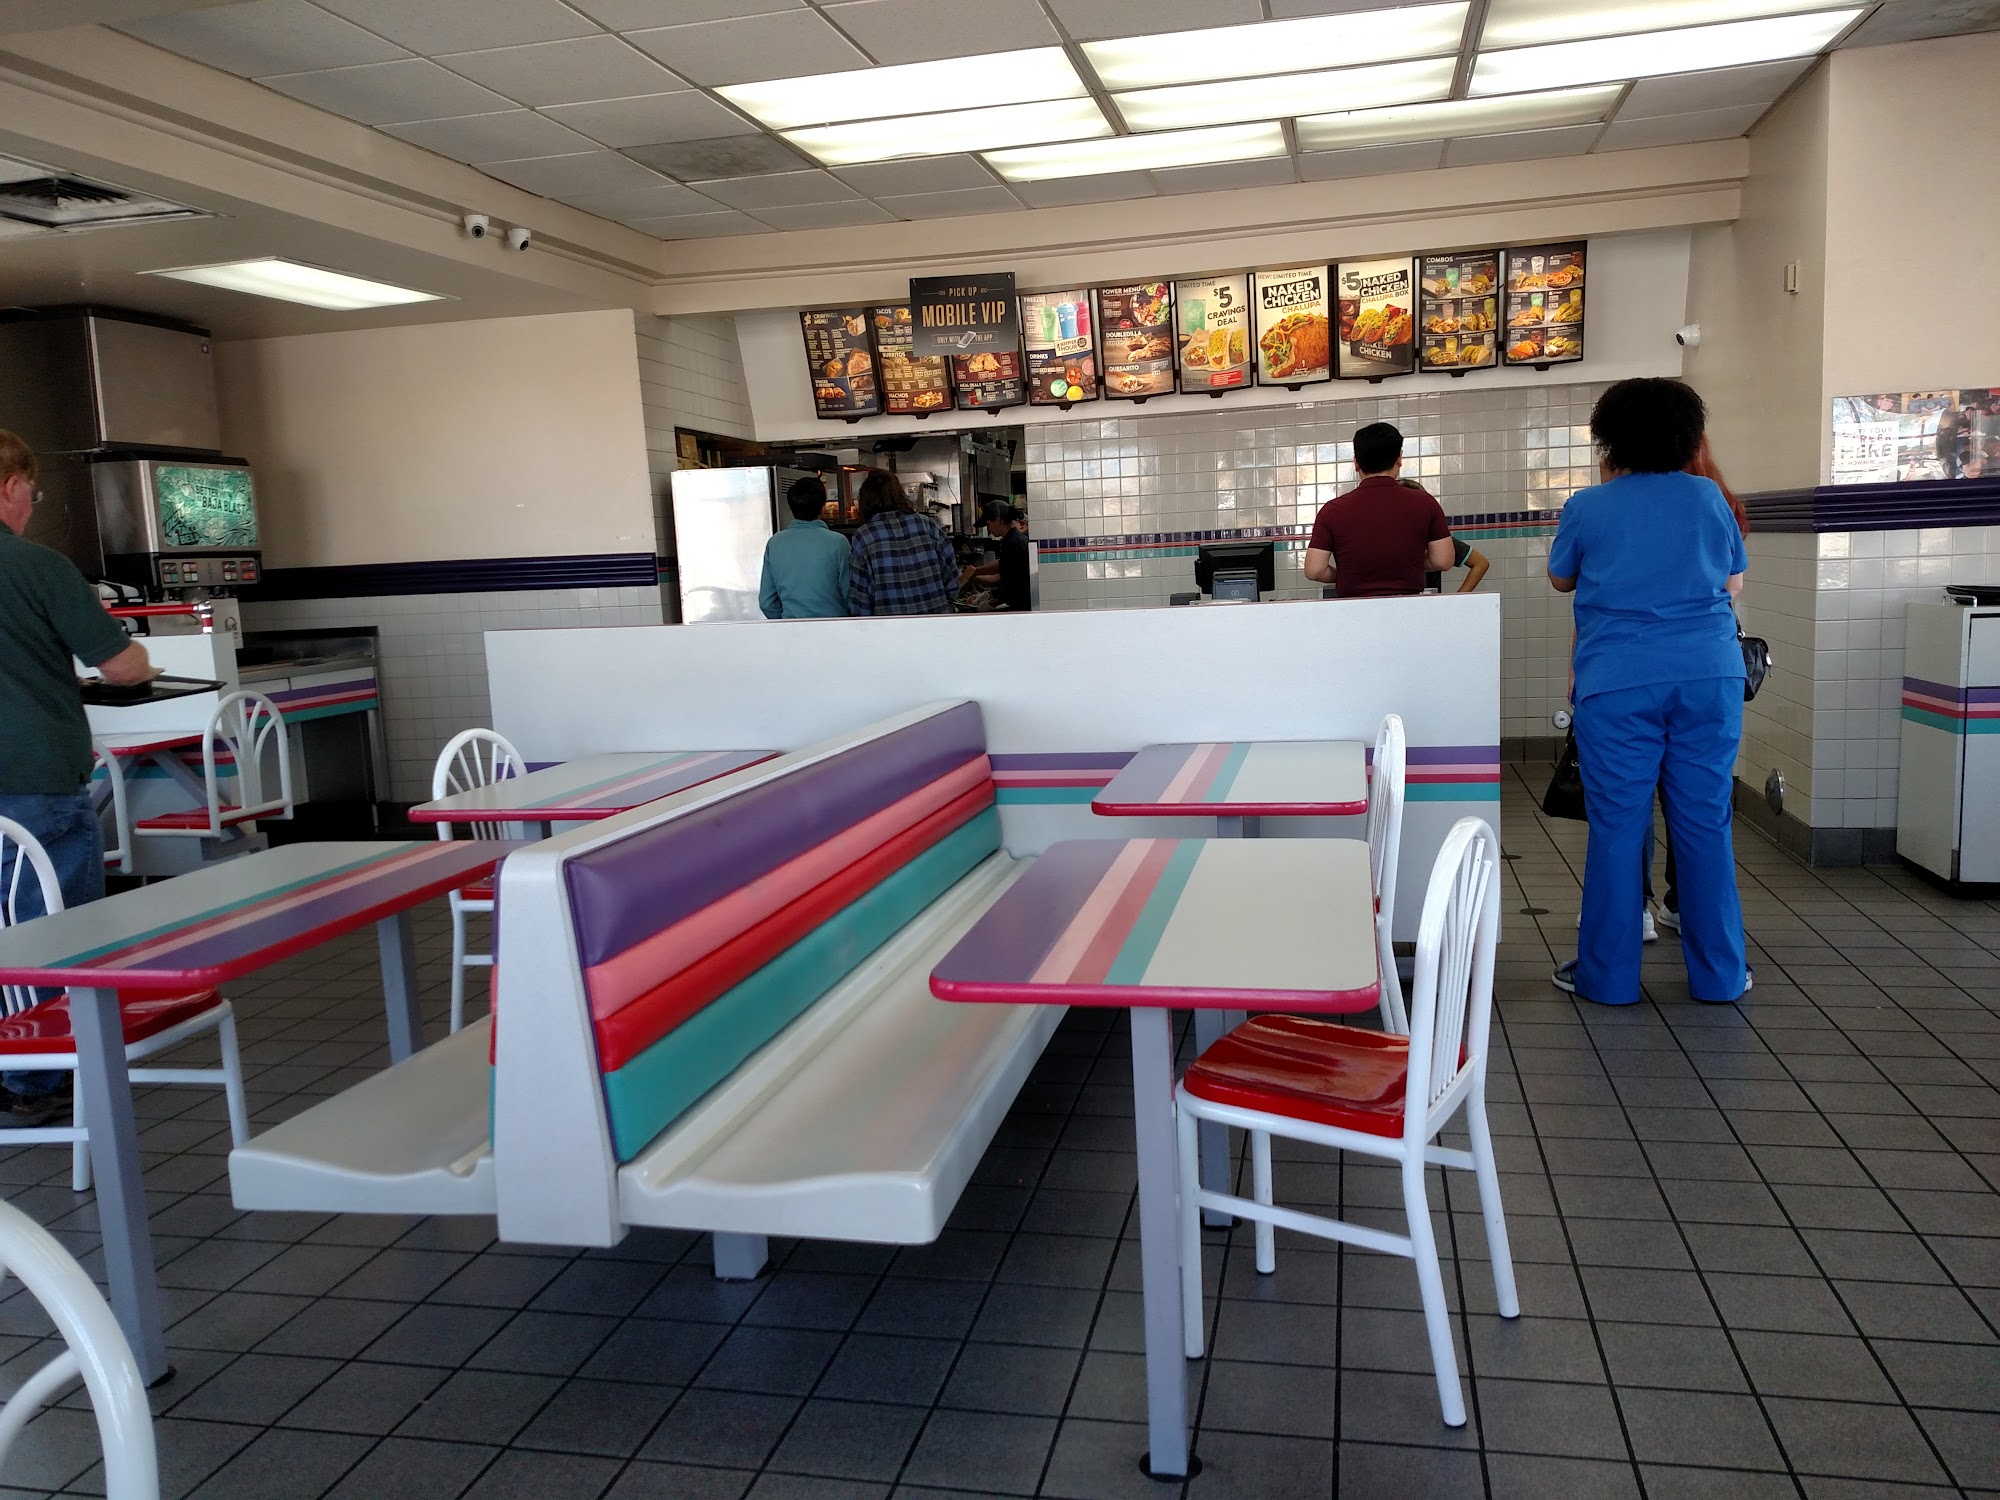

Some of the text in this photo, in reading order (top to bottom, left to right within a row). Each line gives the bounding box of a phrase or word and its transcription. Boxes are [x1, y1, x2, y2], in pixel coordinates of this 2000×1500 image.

[1362, 272, 1402, 288] NAKED
[948, 286, 977, 297] PICK UP
[1267, 280, 1314, 298] NAKED
[1360, 280, 1409, 297] CHICKEN
[1264, 288, 1320, 308] CHICKEN
[1361, 289, 1409, 304] CHALUPA BOX
[922, 303, 977, 327] MOBILE
[981, 301, 1006, 324] VIP
[1207, 305, 1246, 320] CRAVINGS
[1281, 300, 1321, 313] CHALUPA
[804, 312, 811, 327] $
[1217, 316, 1238, 327] DEAL
[937, 336, 948, 344] ONLY
[984, 333, 993, 341] APP
[1359, 346, 1392, 359] CHICKEN
[195, 485, 219, 497] BETTER
[202, 496, 222, 510] BAJA
[223, 500, 246, 514] BLAST
